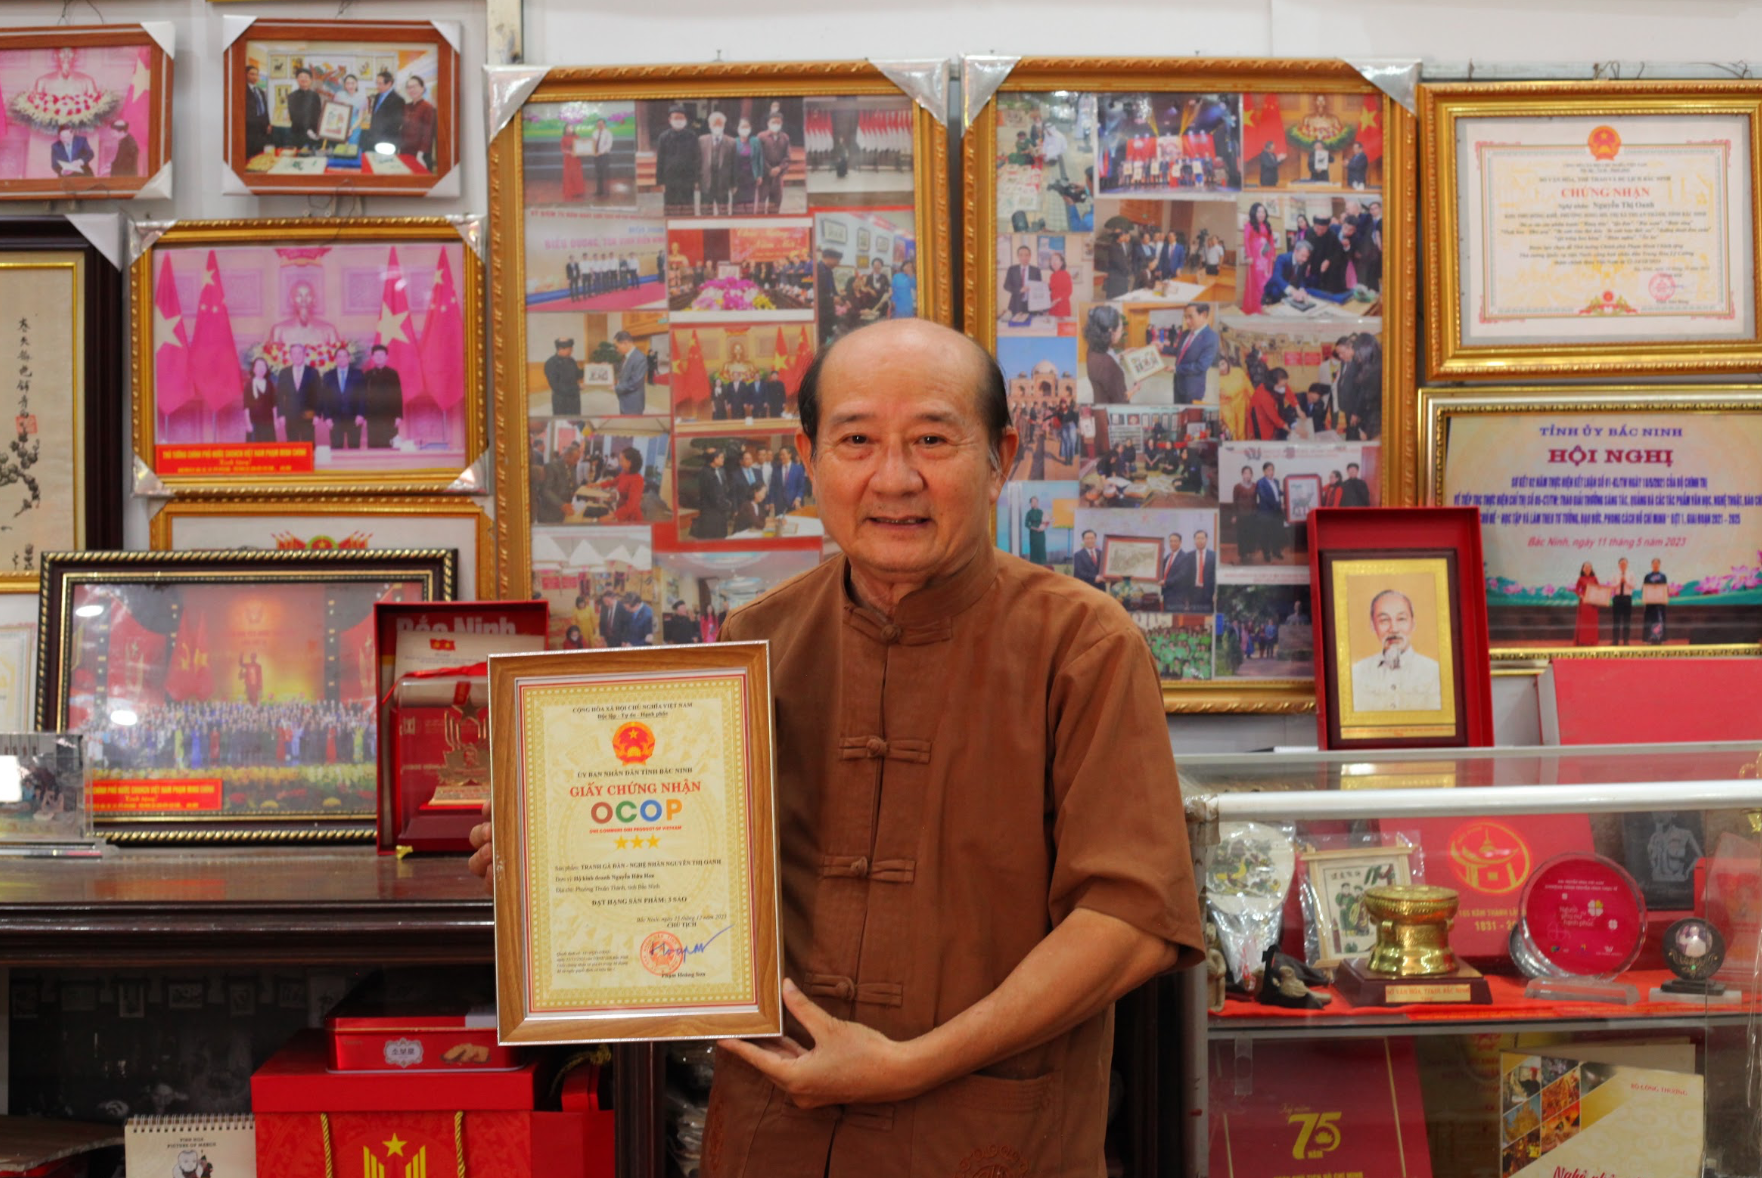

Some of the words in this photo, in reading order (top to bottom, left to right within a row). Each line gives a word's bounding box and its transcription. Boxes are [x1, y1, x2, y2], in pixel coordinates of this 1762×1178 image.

[1561, 186, 1610, 198] CHỨNG
[1612, 186, 1650, 199] NHẬN
[1539, 423, 1578, 436] TỈNH
[1582, 424, 1604, 437] ỦY
[1608, 424, 1638, 437] BẮC
[1642, 428, 1683, 437] NINH
[1548, 444, 1598, 467] HỘI
[1604, 449, 1674, 468] NGHỊ
[1528, 536, 1545, 547] Bắc
[1572, 537, 1595, 549] ngày
[1608, 537, 1634, 549] tháng
[1636, 538, 1642, 546] 5
[1664, 537, 1686, 547] 2023
[454, 616, 516, 634] Ninh
[570, 782, 603, 797] GIẤY
[607, 781, 657, 796] CHỨNG
[661, 779, 701, 794] NHẬN
[591, 799, 683, 824] OCOP
[1475, 921, 1496, 931] 1831
[1641, 1084, 1658, 1092] CÔNG
[1288, 1112, 1342, 1160] 75
